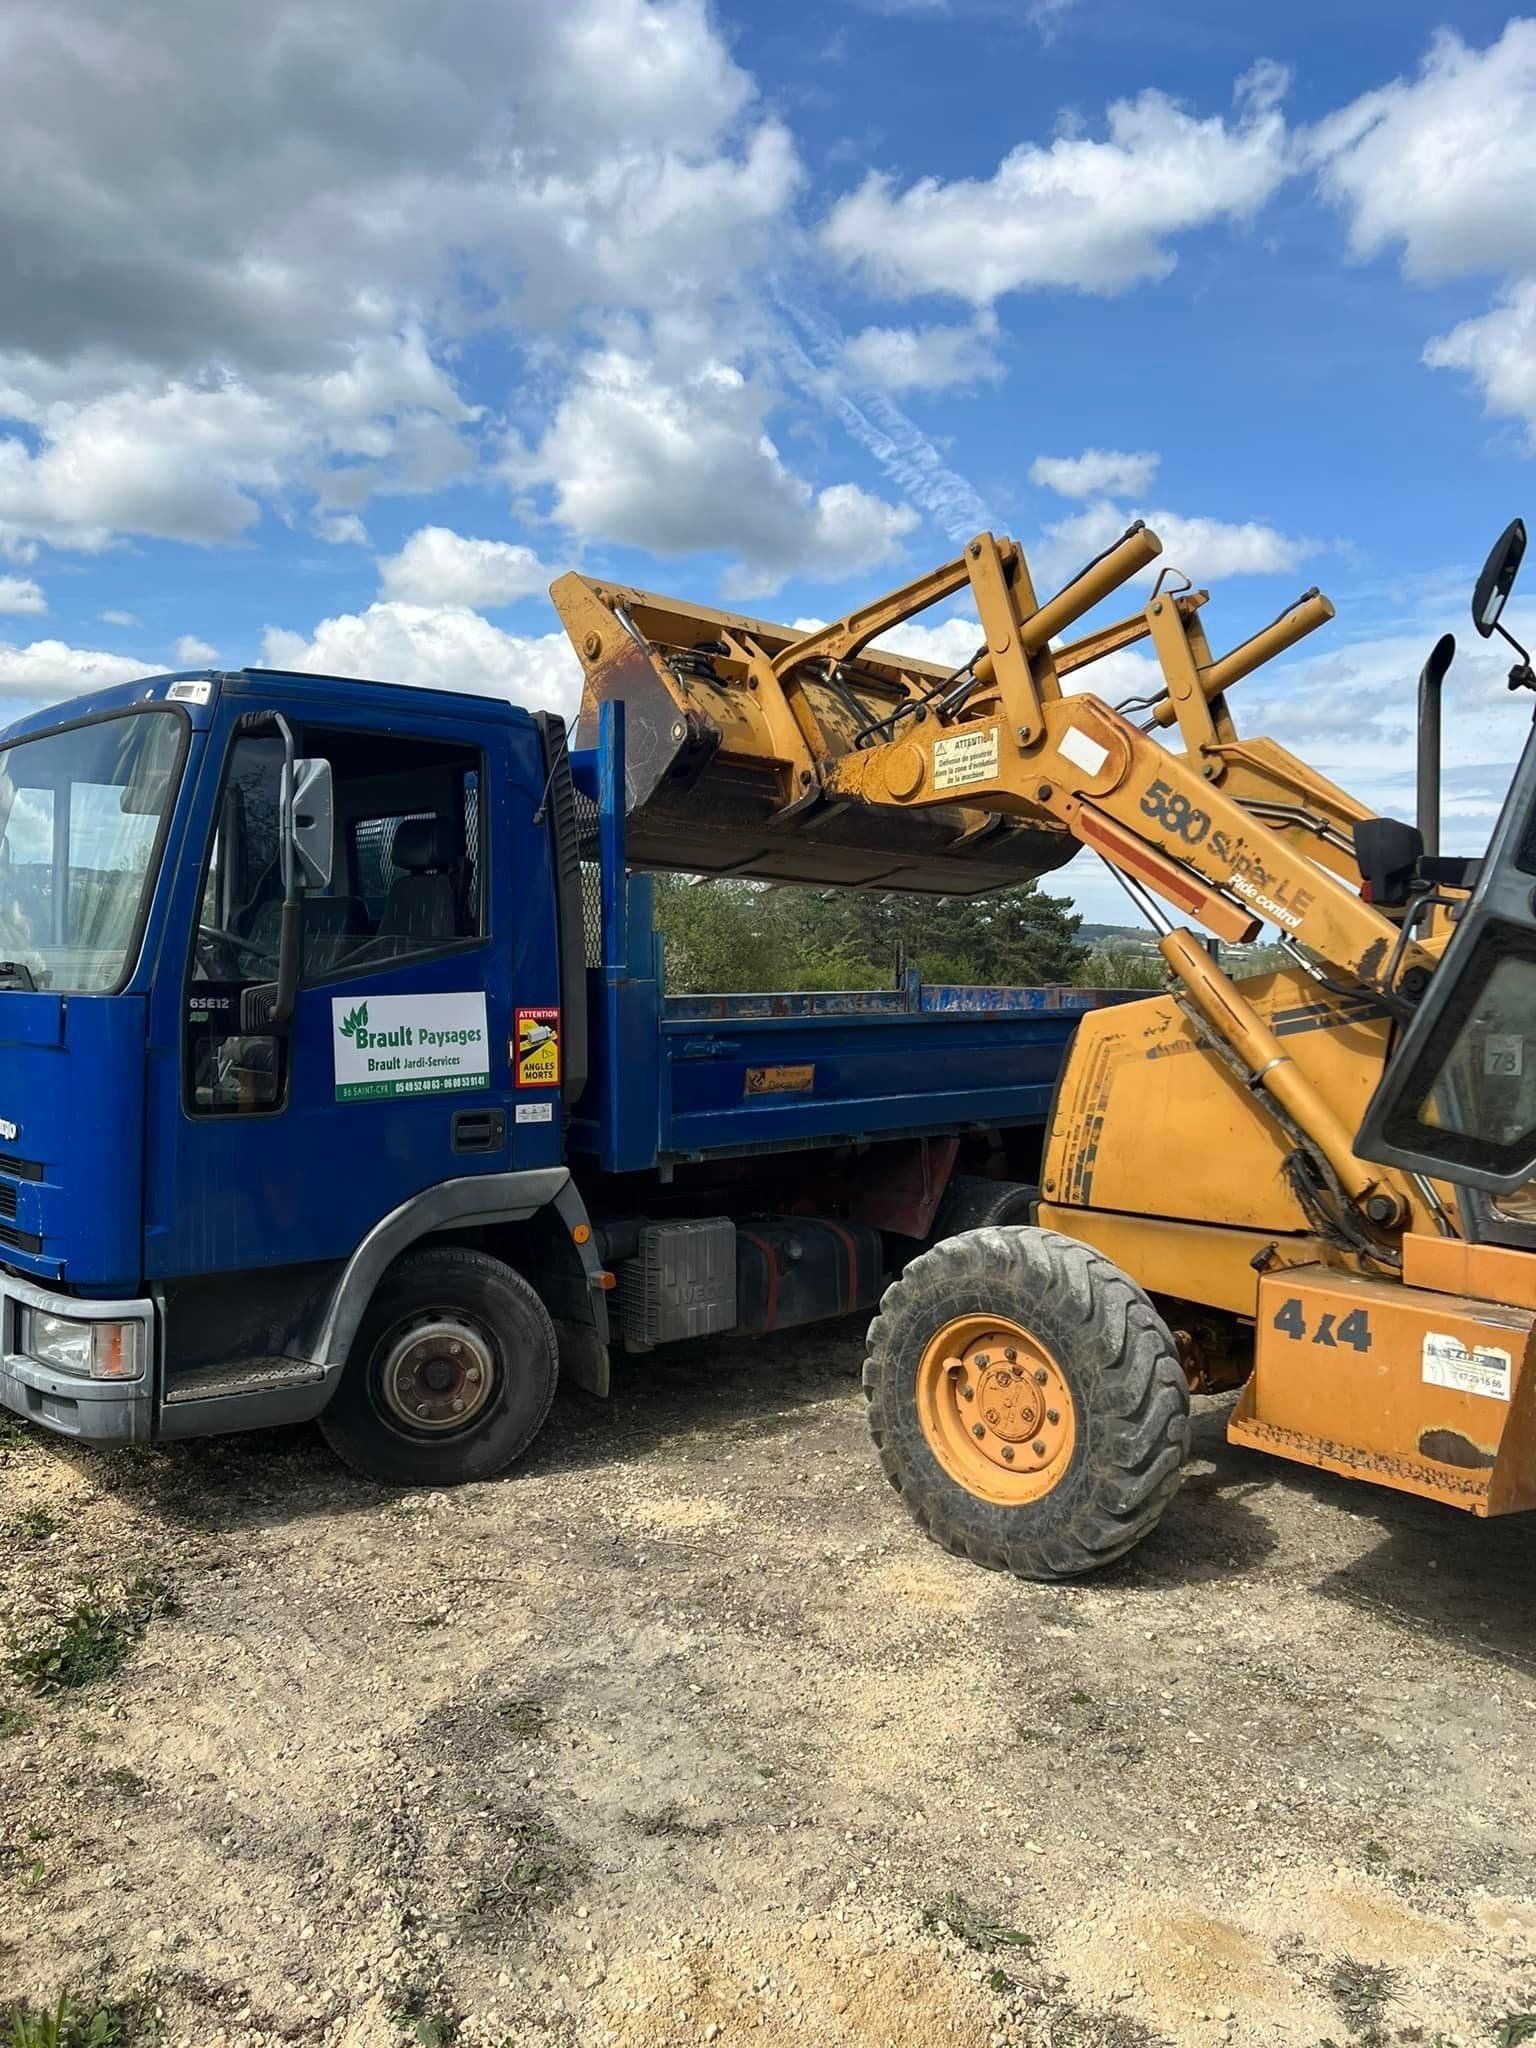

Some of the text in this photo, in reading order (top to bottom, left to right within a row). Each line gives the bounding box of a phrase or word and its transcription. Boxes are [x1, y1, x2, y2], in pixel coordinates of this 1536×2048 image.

[1140, 779, 1211, 845] 580
[1228, 873, 1304, 929] Ride control
[519, 1010, 558, 1018] ATTENTION
[355, 1026, 482, 1049] Brault Paysages
[367, 1056, 461, 1072] Brault Jardi-Services
[524, 1062, 555, 1071] ANGLES
[525, 1070, 553, 1080] MORTS
[1273, 1298, 1372, 1353] 4x4
